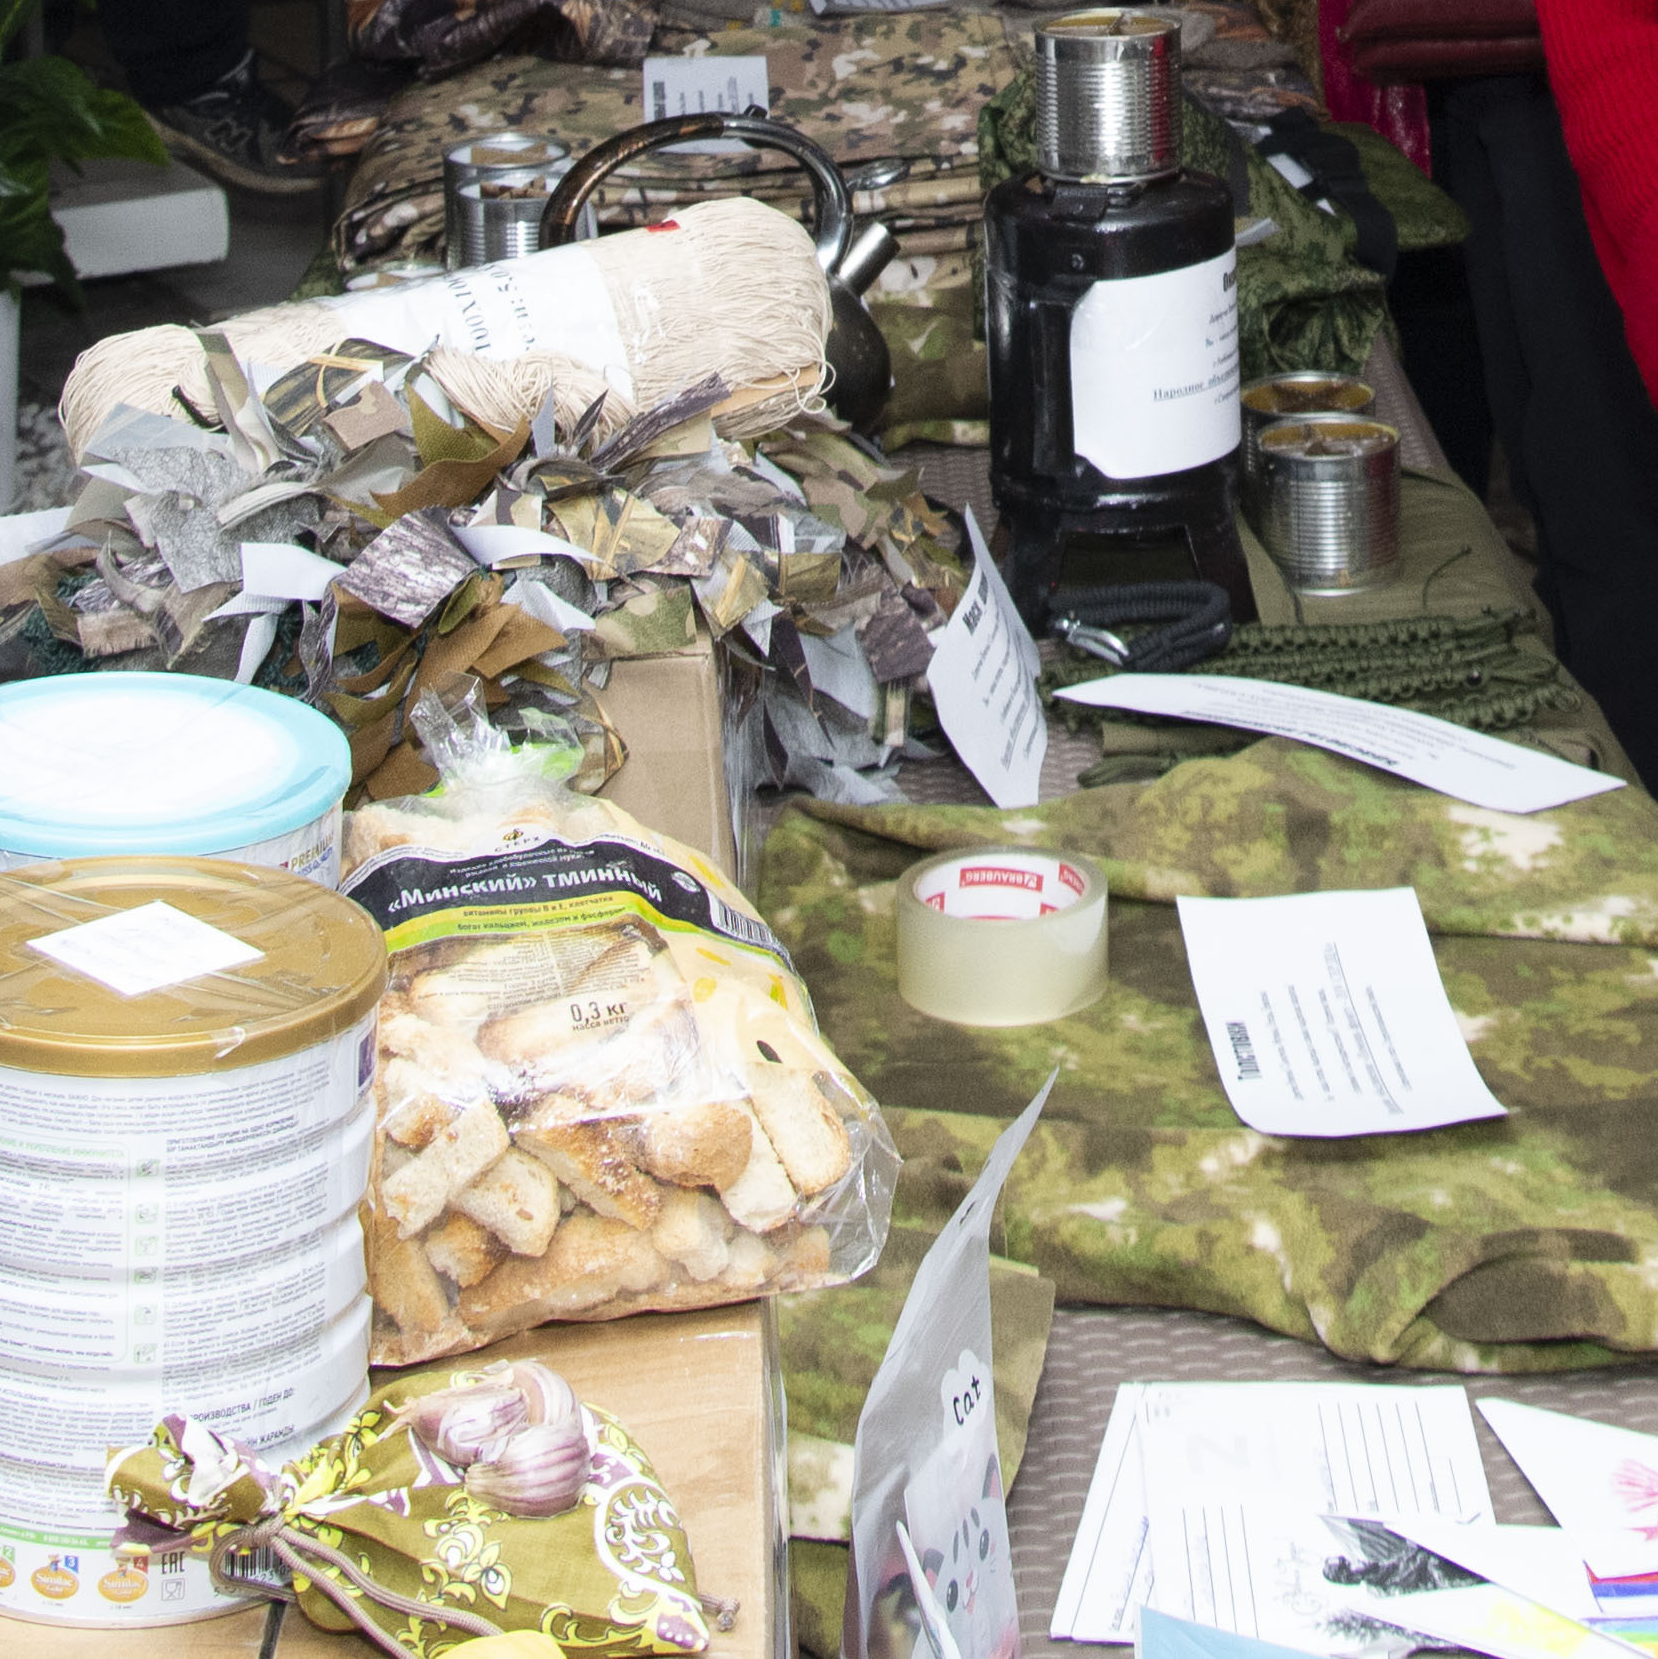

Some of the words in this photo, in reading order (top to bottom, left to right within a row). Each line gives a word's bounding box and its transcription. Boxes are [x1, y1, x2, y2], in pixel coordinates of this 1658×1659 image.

[964, 869, 1023, 886] BRAUBERG
[387, 872, 537, 913] «Минский»
[542, 867, 663, 903] тминный
[463, 907, 507, 917] витамины
[509, 906, 541, 917] группы
[569, 896, 614, 910] клетчатка
[458, 923, 481, 932] богат
[483, 920, 528, 932] кальцием,
[532, 916, 571, 928] железом
[570, 1002, 601, 1026] 0,3
[607, 1002, 627, 1016] кг
[572, 1020, 601, 1032] масса
[603, 1016, 630, 1027] нетто
[190, 1402, 251, 1422] РОИЗВОДСТВА
[258, 1390, 282, 1408] ГОДЕН
[161, 1551, 186, 1575] EAC
[34, 1572, 76, 1587] Similac
[103, 1575, 145, 1589] Similac
